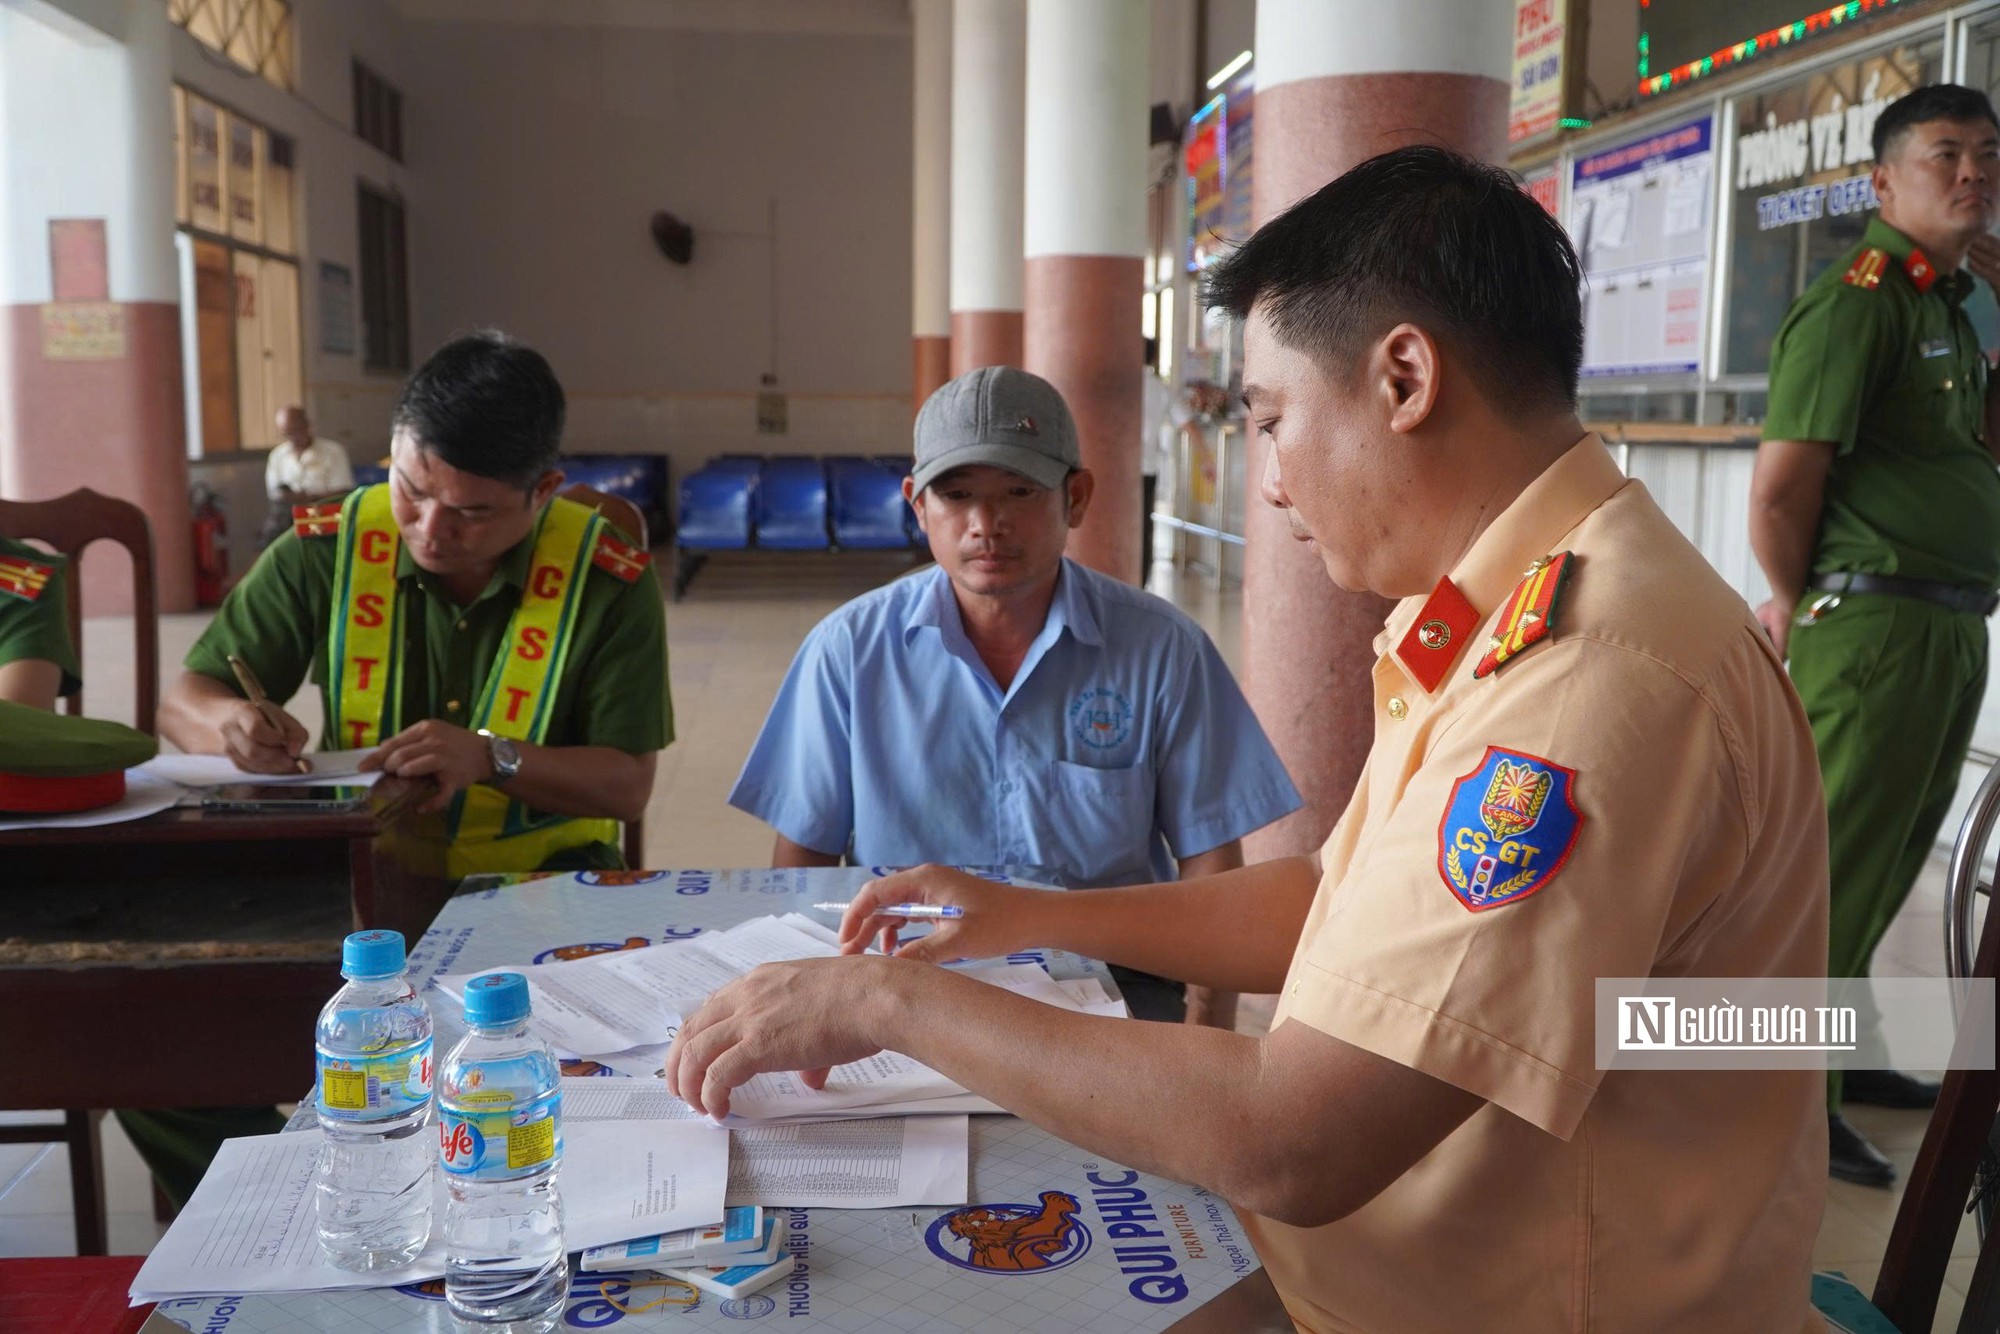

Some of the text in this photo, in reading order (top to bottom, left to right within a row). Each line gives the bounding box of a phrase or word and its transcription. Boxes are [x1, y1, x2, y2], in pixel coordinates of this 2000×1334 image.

[1757, 182, 1827, 231] TICKET
[1494, 809, 1521, 823] CAND
[1456, 827, 1541, 868] CS GT
[1203, 1202, 1224, 1222] Inox
[784, 1234, 815, 1259] HIỆU
[1085, 1169, 1190, 1304] QUI PHUC
[1166, 1203, 1208, 1260] FURNITURE
[1222, 1244, 1251, 1273] Ngoại
